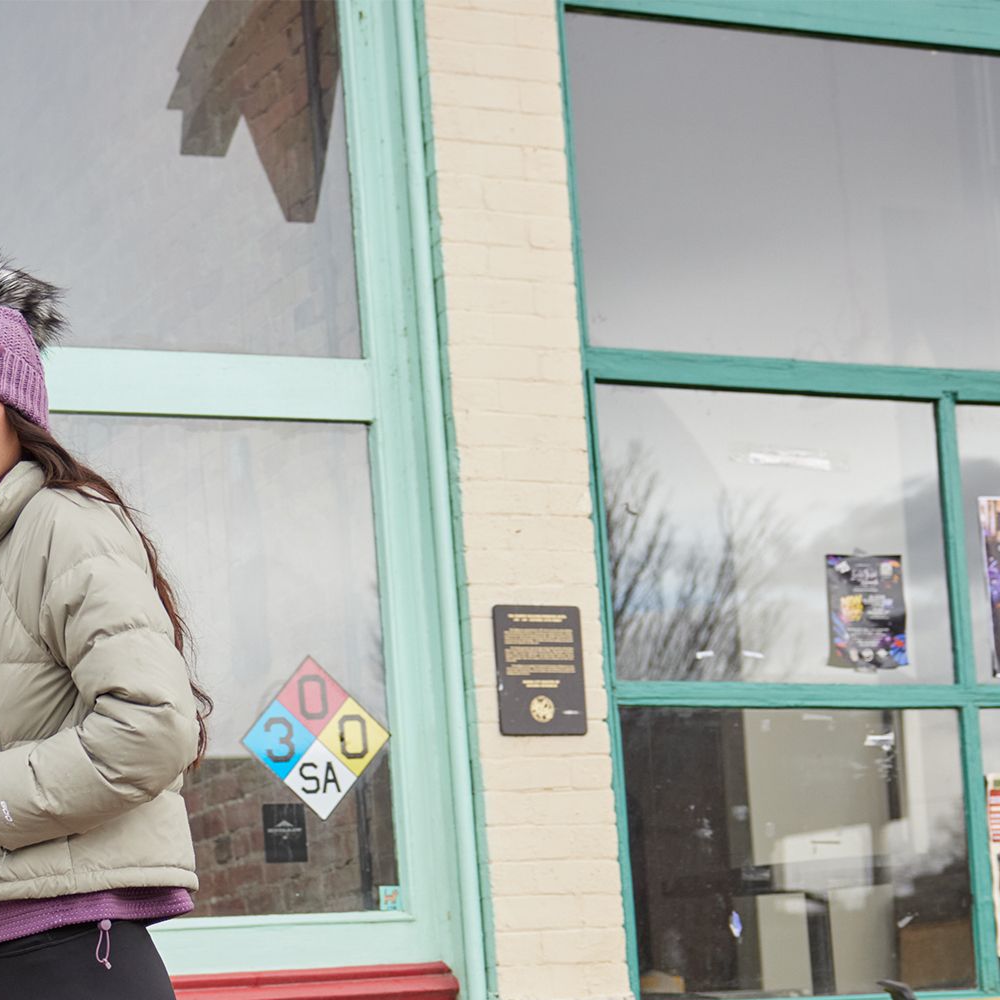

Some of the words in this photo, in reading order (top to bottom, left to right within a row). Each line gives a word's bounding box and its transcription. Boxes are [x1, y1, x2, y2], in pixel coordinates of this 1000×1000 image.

[297, 674, 329, 720] 0
[263, 716, 296, 763] 3
[338, 713, 369, 760] 0
[299, 761, 341, 794] SA
